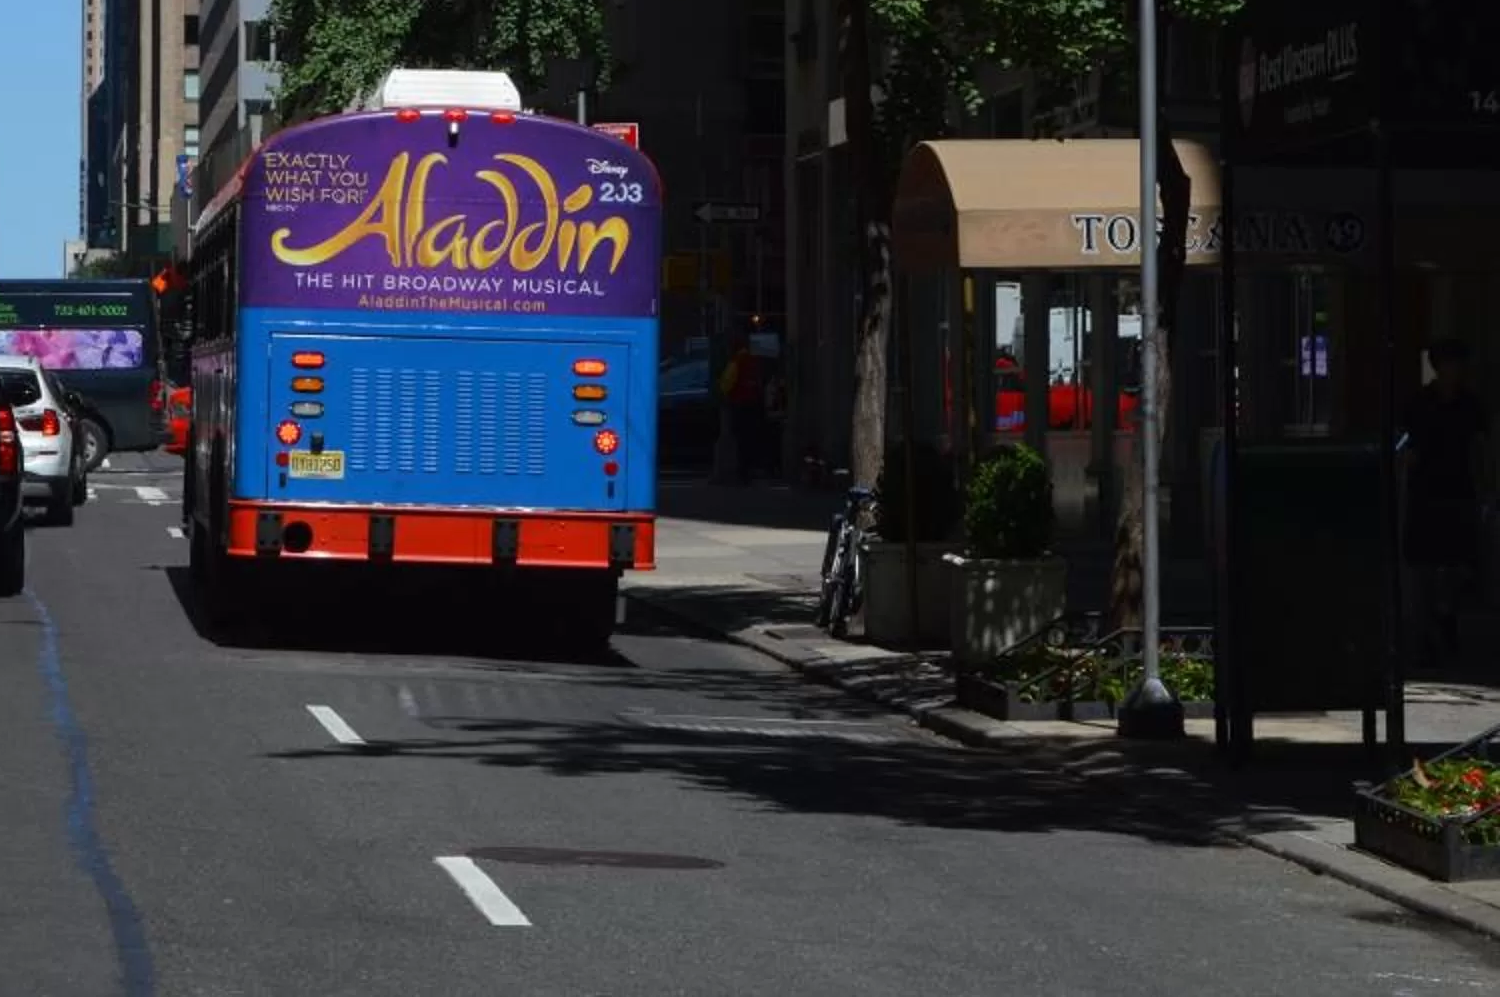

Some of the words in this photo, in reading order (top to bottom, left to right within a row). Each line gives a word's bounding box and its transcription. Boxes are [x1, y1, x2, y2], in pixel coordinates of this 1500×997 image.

[1327, 22, 1359, 76] PLUS
[265, 170, 323, 185] WHAT
[328, 172, 369, 188] YOU
[585, 157, 629, 179] Disney
[265, 186, 315, 203] WISH
[599, 181, 643, 203] 203
[271, 151, 630, 275] Aladdin
[295, 272, 333, 289] THE
[341, 273, 375, 290] HIT
[383, 274, 504, 293] BROADWAY
[512, 278, 605, 297] MUSICAL
[358, 294, 546, 312] AladdinTheMusical.com
